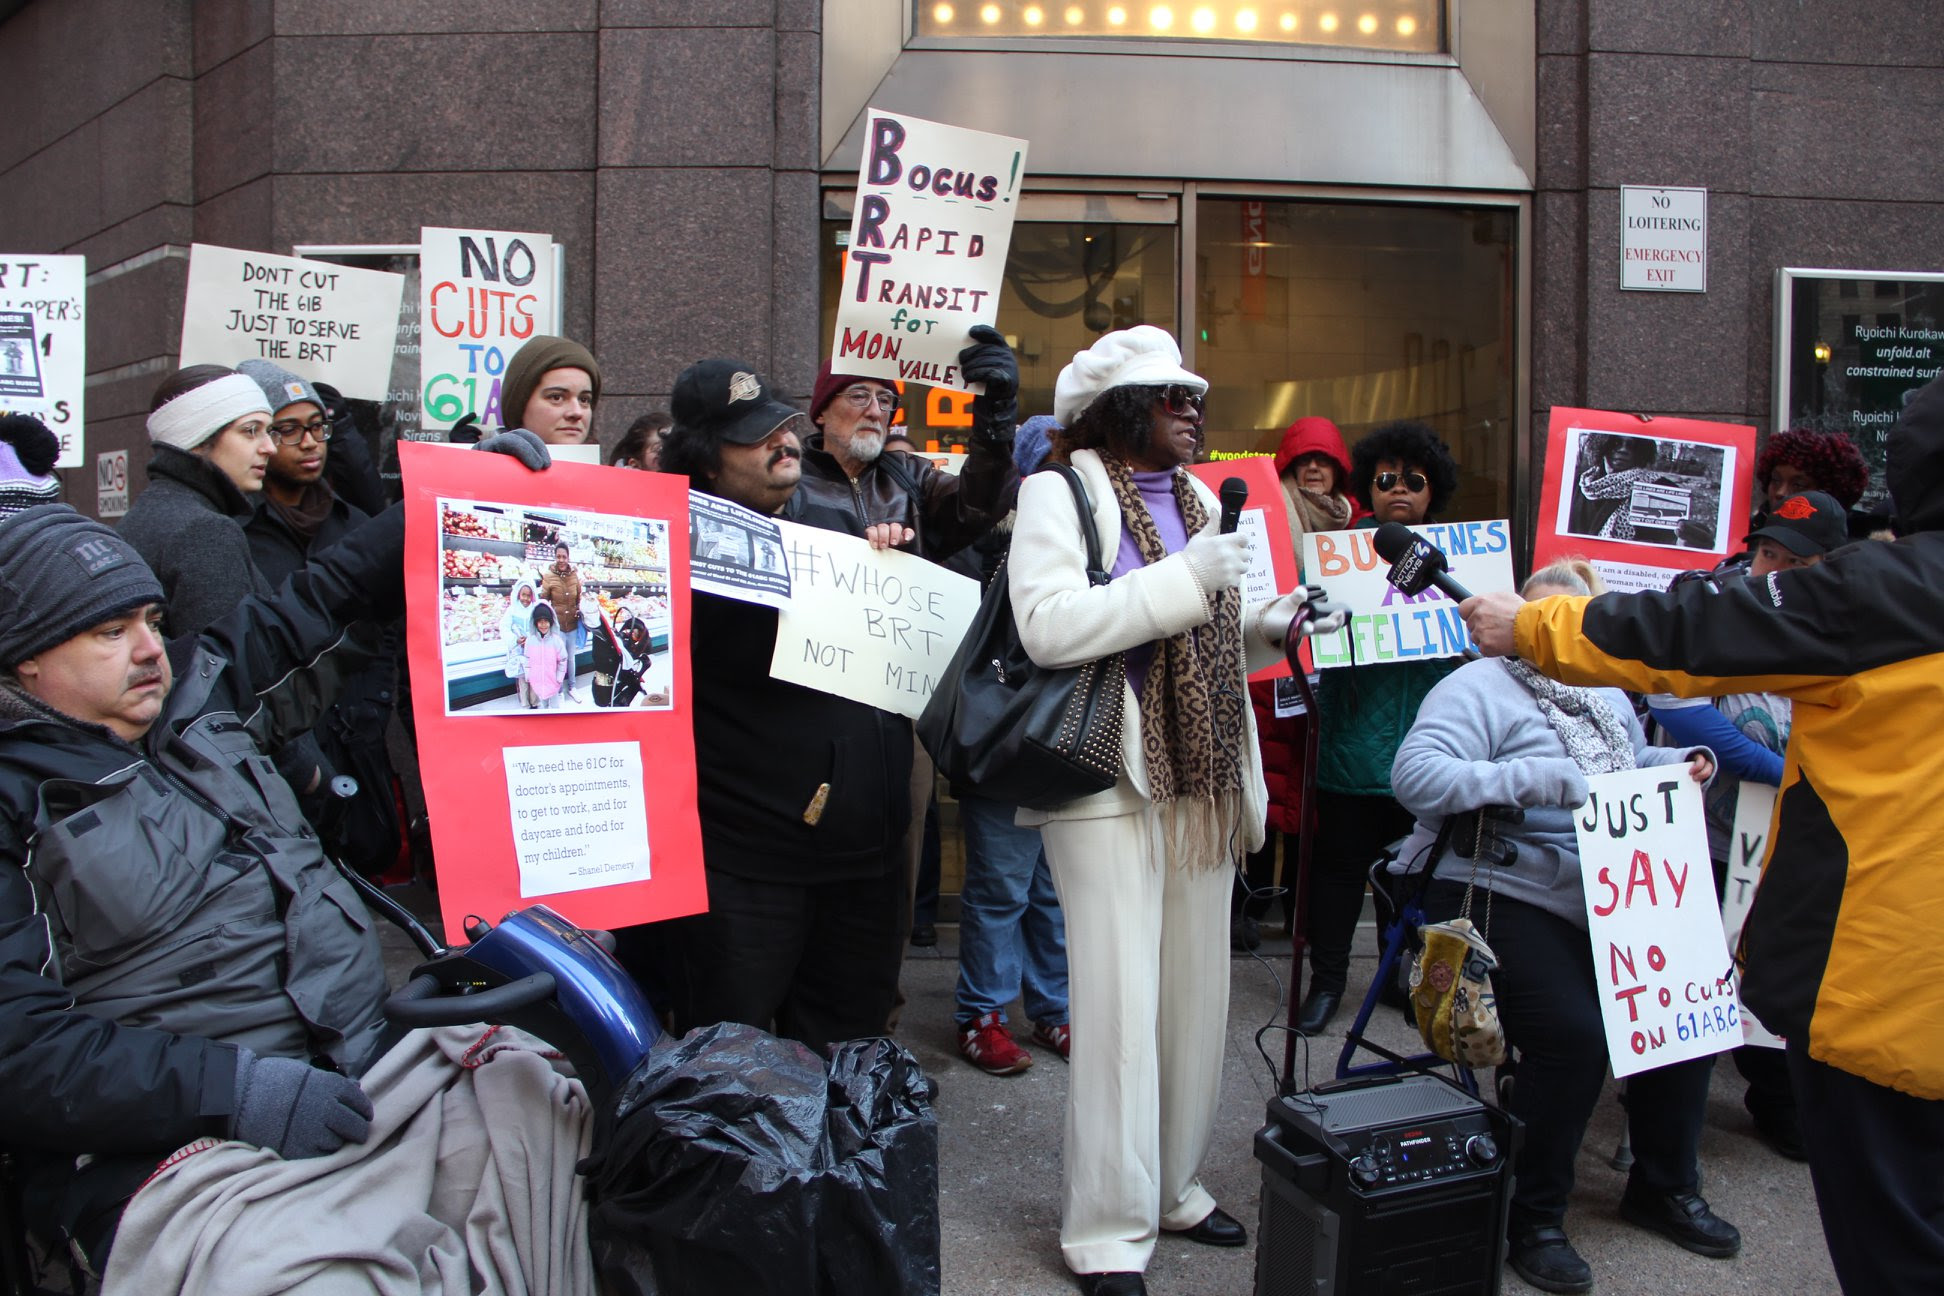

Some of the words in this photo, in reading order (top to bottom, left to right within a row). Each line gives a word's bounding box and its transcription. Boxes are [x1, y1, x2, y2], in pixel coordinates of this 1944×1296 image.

[1652, 195, 1671, 210] NO
[856, 194, 984, 258] RAPID
[1628, 216, 1701, 232] LOITERING
[458, 236, 536, 286] NO
[1625, 248, 1703, 263] EMERGENCY
[243, 262, 293, 285] DONT
[300, 271, 339, 291] CUT
[852, 250, 988, 313] TRANSIT
[1647, 268, 1676, 282] EXIT
[254, 290, 290, 311] THE
[430, 281, 537, 340] CUTS
[225, 310, 276, 335] JUST
[287, 317, 306, 336] TO
[306, 319, 361, 340] SERVE
[890, 308, 939, 335] for
[1855, 325, 1896, 341] Ryoichi
[256, 338, 291, 359] THE
[299, 341, 337, 363] BRT
[458, 343, 505, 376] TO
[839, 327, 902, 361] MON
[899, 359, 970, 390] VALLE
[1876, 346, 1931, 361] unfold.alt
[1846, 365, 1914, 379] constrained
[1853, 410, 1893, 426] Ryoichi
[403, 429, 441, 442] Sirens
[100, 458, 113, 487] NO
[99, 496, 128, 512] SMOKING
[1315, 531, 1391, 577] BU
[787, 540, 945, 621] #WHOSE
[1394, 553, 1418, 588] ACTION
[1402, 559, 1423, 587] NEWS
[1606, 579, 1634, 587] woman
[1636, 581, 1657, 589] that's
[1624, 569, 1660, 580] disabled,
[863, 607, 943, 656] BRT
[1314, 606, 1480, 664] LIFELIN
[803, 638, 854, 673] NOT
[538, 760, 565, 774] need
[567, 760, 584, 772] the
[586, 757, 607, 770] 61C
[609, 757, 625, 769] for
[515, 783, 557, 797] doctor's
[559, 778, 631, 796] appointments,
[517, 809, 528, 819] to
[530, 806, 548, 821] get
[549, 805, 560, 817] to
[562, 802, 590, 815] work,
[592, 799, 611, 812] and
[613, 798, 627, 809] for
[1582, 781, 1678, 839] JUST
[520, 828, 562, 844] daycare
[564, 824, 583, 837] and
[585, 821, 609, 834] food
[610, 819, 625, 831] for
[524, 853, 540, 866] my
[543, 844, 590, 862] children."
[578, 865, 603, 876] Shanel
[604, 861, 635, 873] Demery
[1593, 849, 1689, 917] SAY
[1610, 941, 1666, 986] NO
[1615, 985, 1671, 1022] TO
[1630, 1025, 1667, 1056] ON
[1400, 1137, 1432, 1147] PATHFINDER
